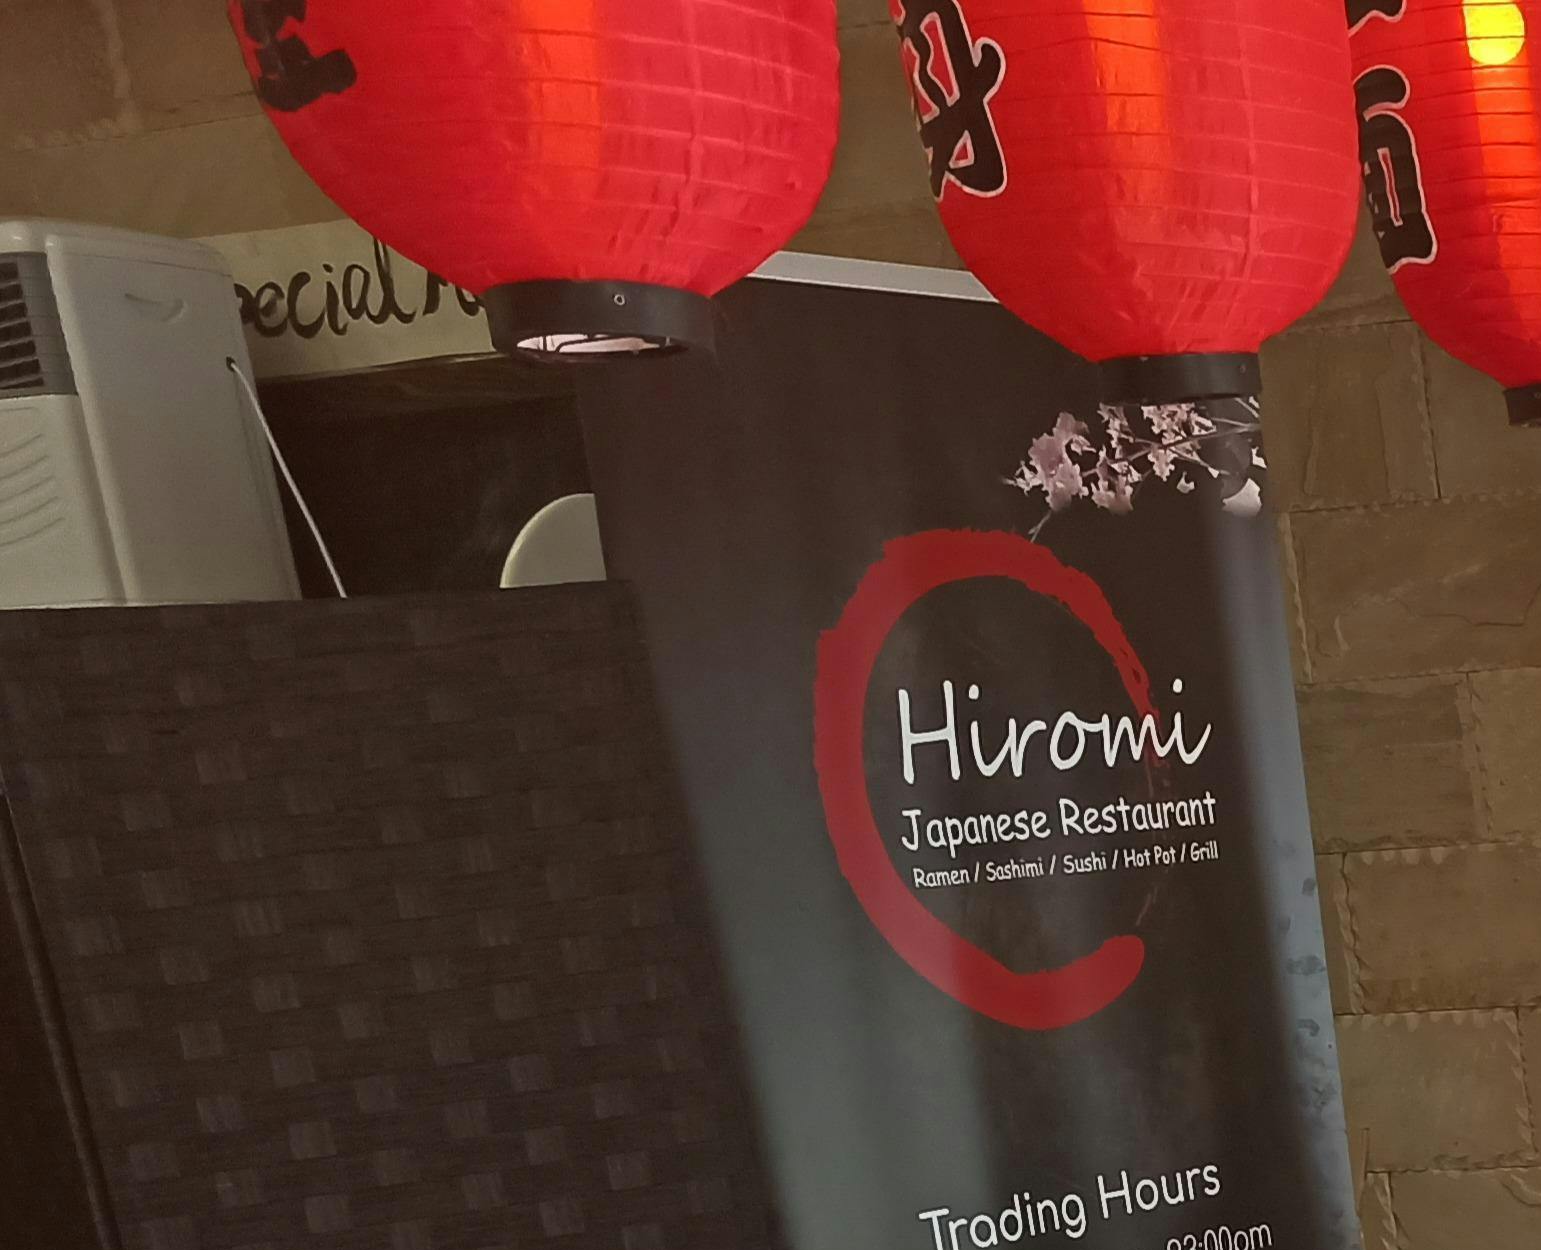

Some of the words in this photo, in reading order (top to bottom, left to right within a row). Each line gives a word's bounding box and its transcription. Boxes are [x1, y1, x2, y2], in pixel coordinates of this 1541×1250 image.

[899, 679, 1213, 784] Hiromi
[902, 809, 1051, 858] Japanese
[1059, 791, 1216, 835] Restaurant
[913, 868, 970, 887] Ramen
[986, 857, 1044, 881] Sashimi
[1064, 852, 1106, 873] Sushi
[1124, 849, 1150, 868] Hot
[1154, 846, 1176, 864] Pot
[1191, 841, 1218, 861] Grill
[1098, 1165, 1220, 1218] Hours
